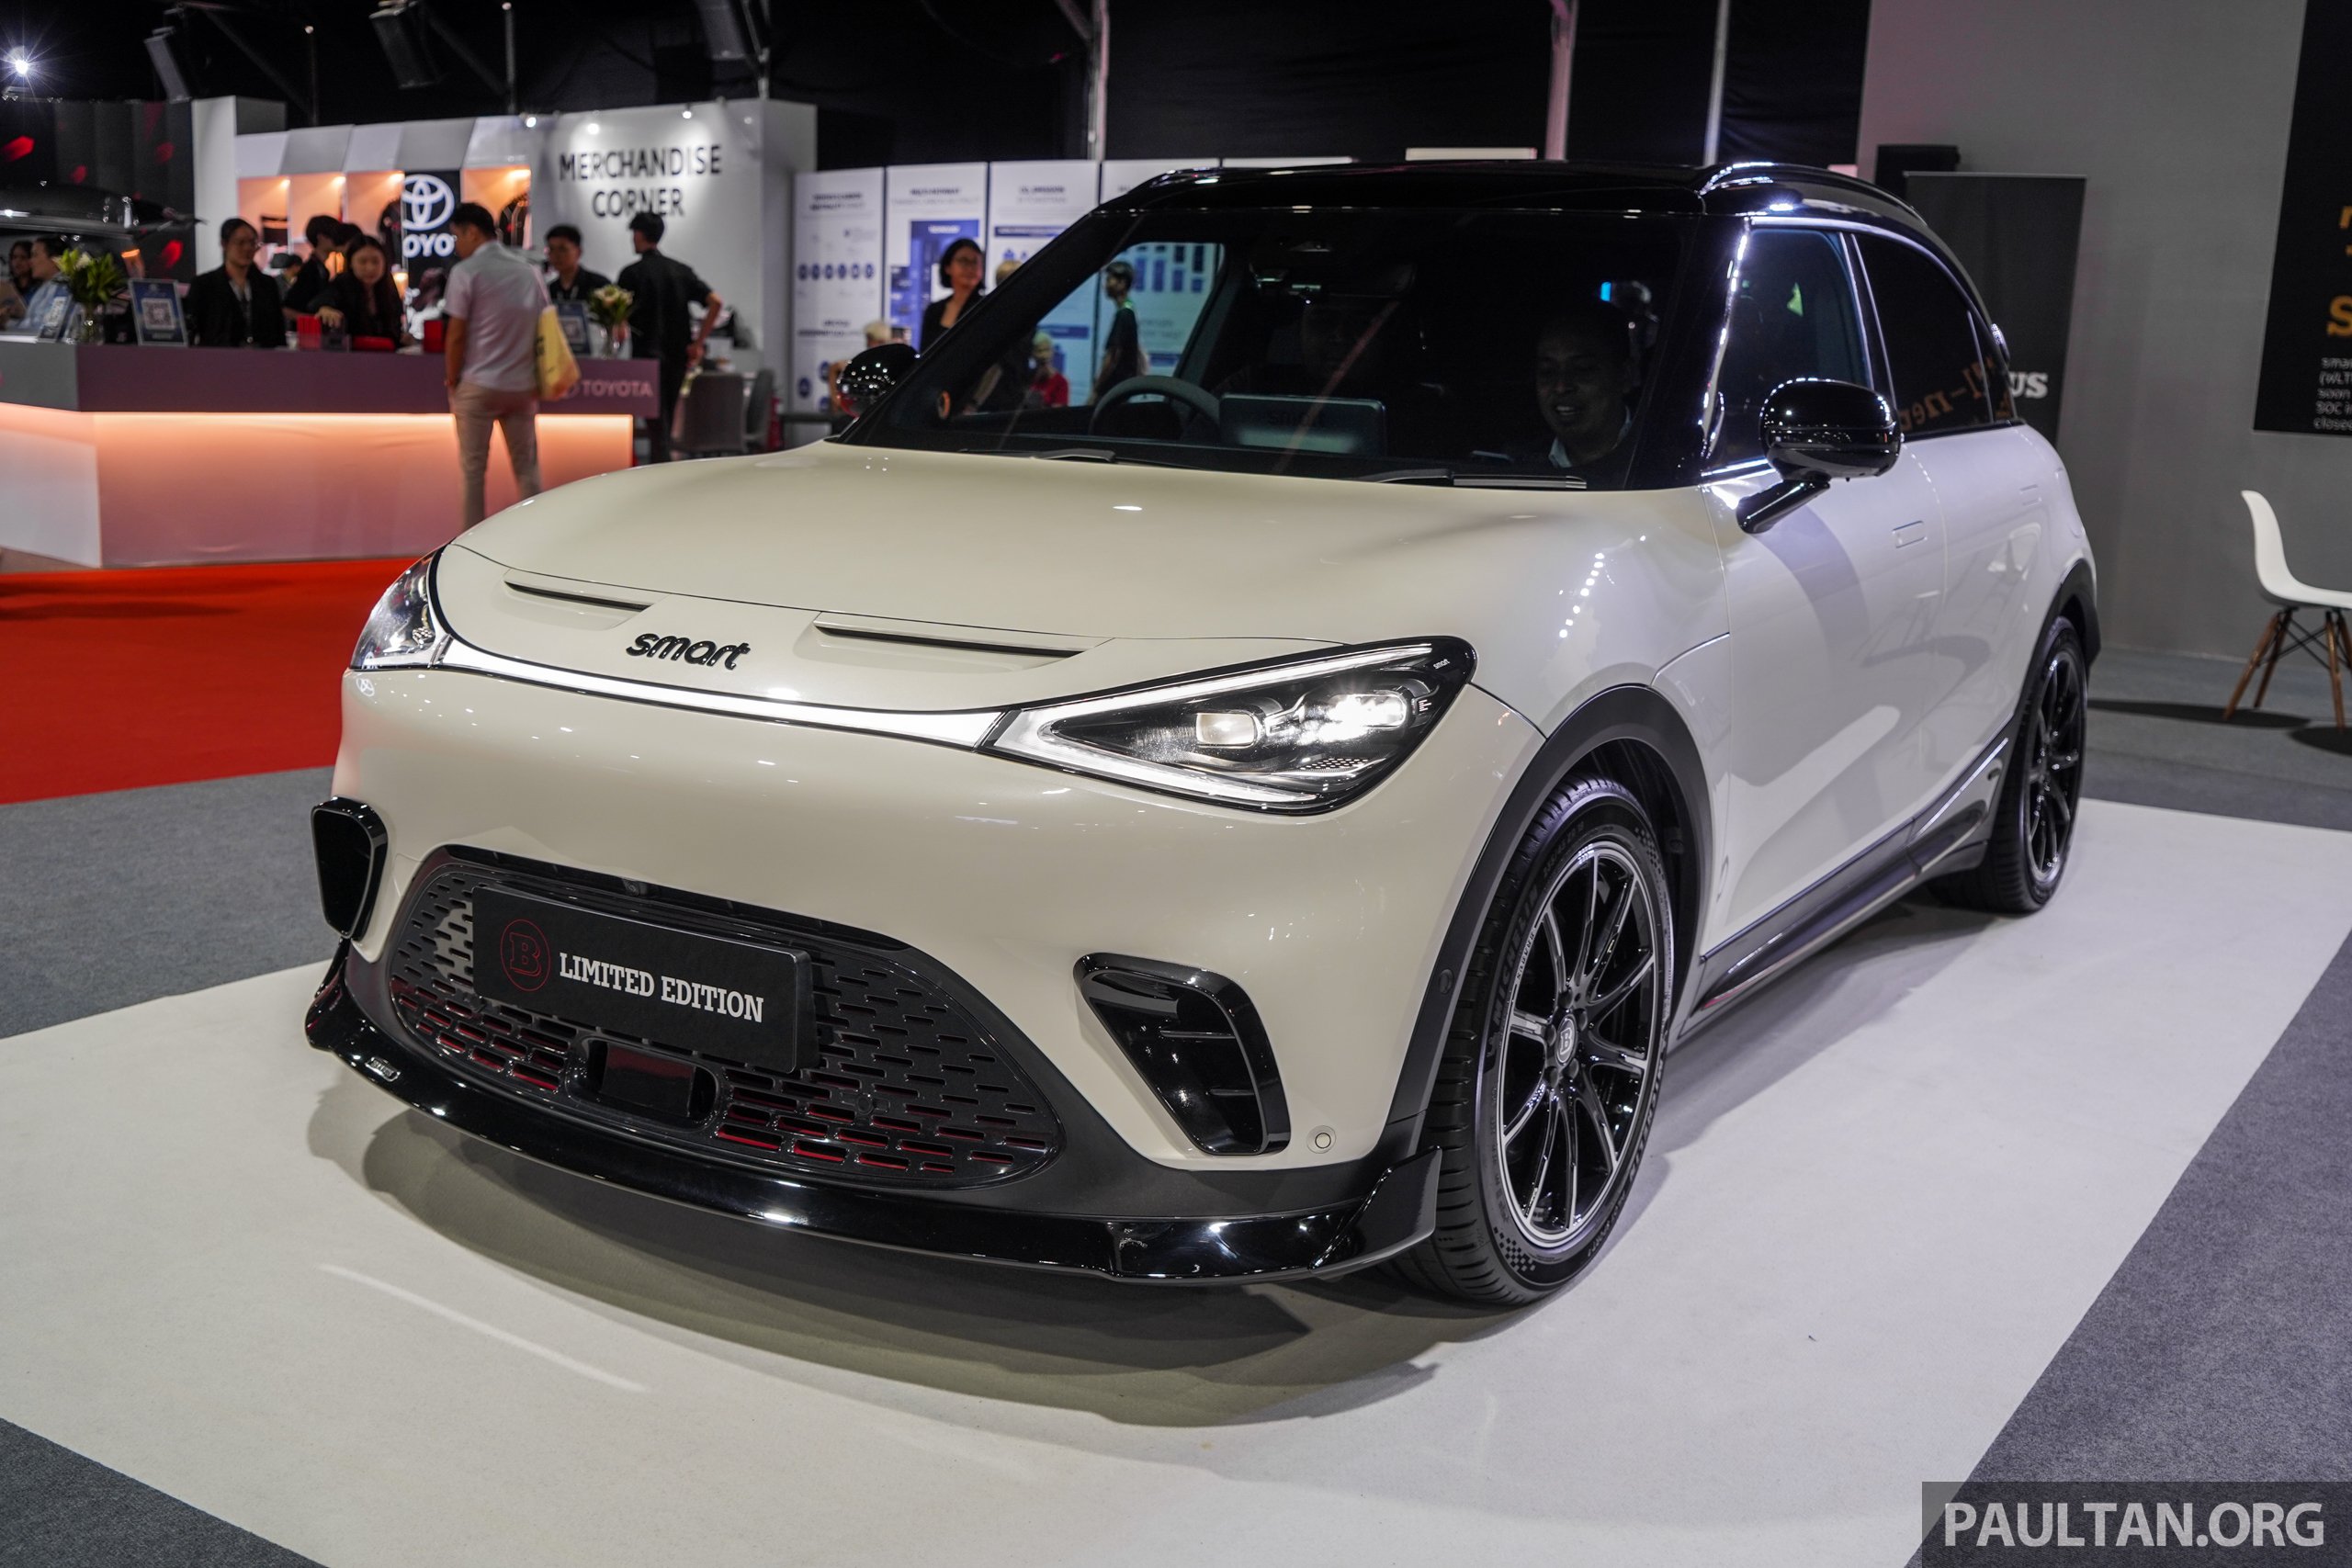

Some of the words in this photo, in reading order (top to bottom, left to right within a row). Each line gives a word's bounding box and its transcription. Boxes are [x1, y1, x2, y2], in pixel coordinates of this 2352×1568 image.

[560, 143, 723, 182] MERCHANDISE
[592, 187, 685, 219] CORNER
[581, 379, 654, 398] TOYOTA
[626, 632, 751, 671] smart
[1432, 659, 1451, 670] smart
[559, 952, 655, 998] LIMITED
[661, 973, 764, 1024] EDITION
